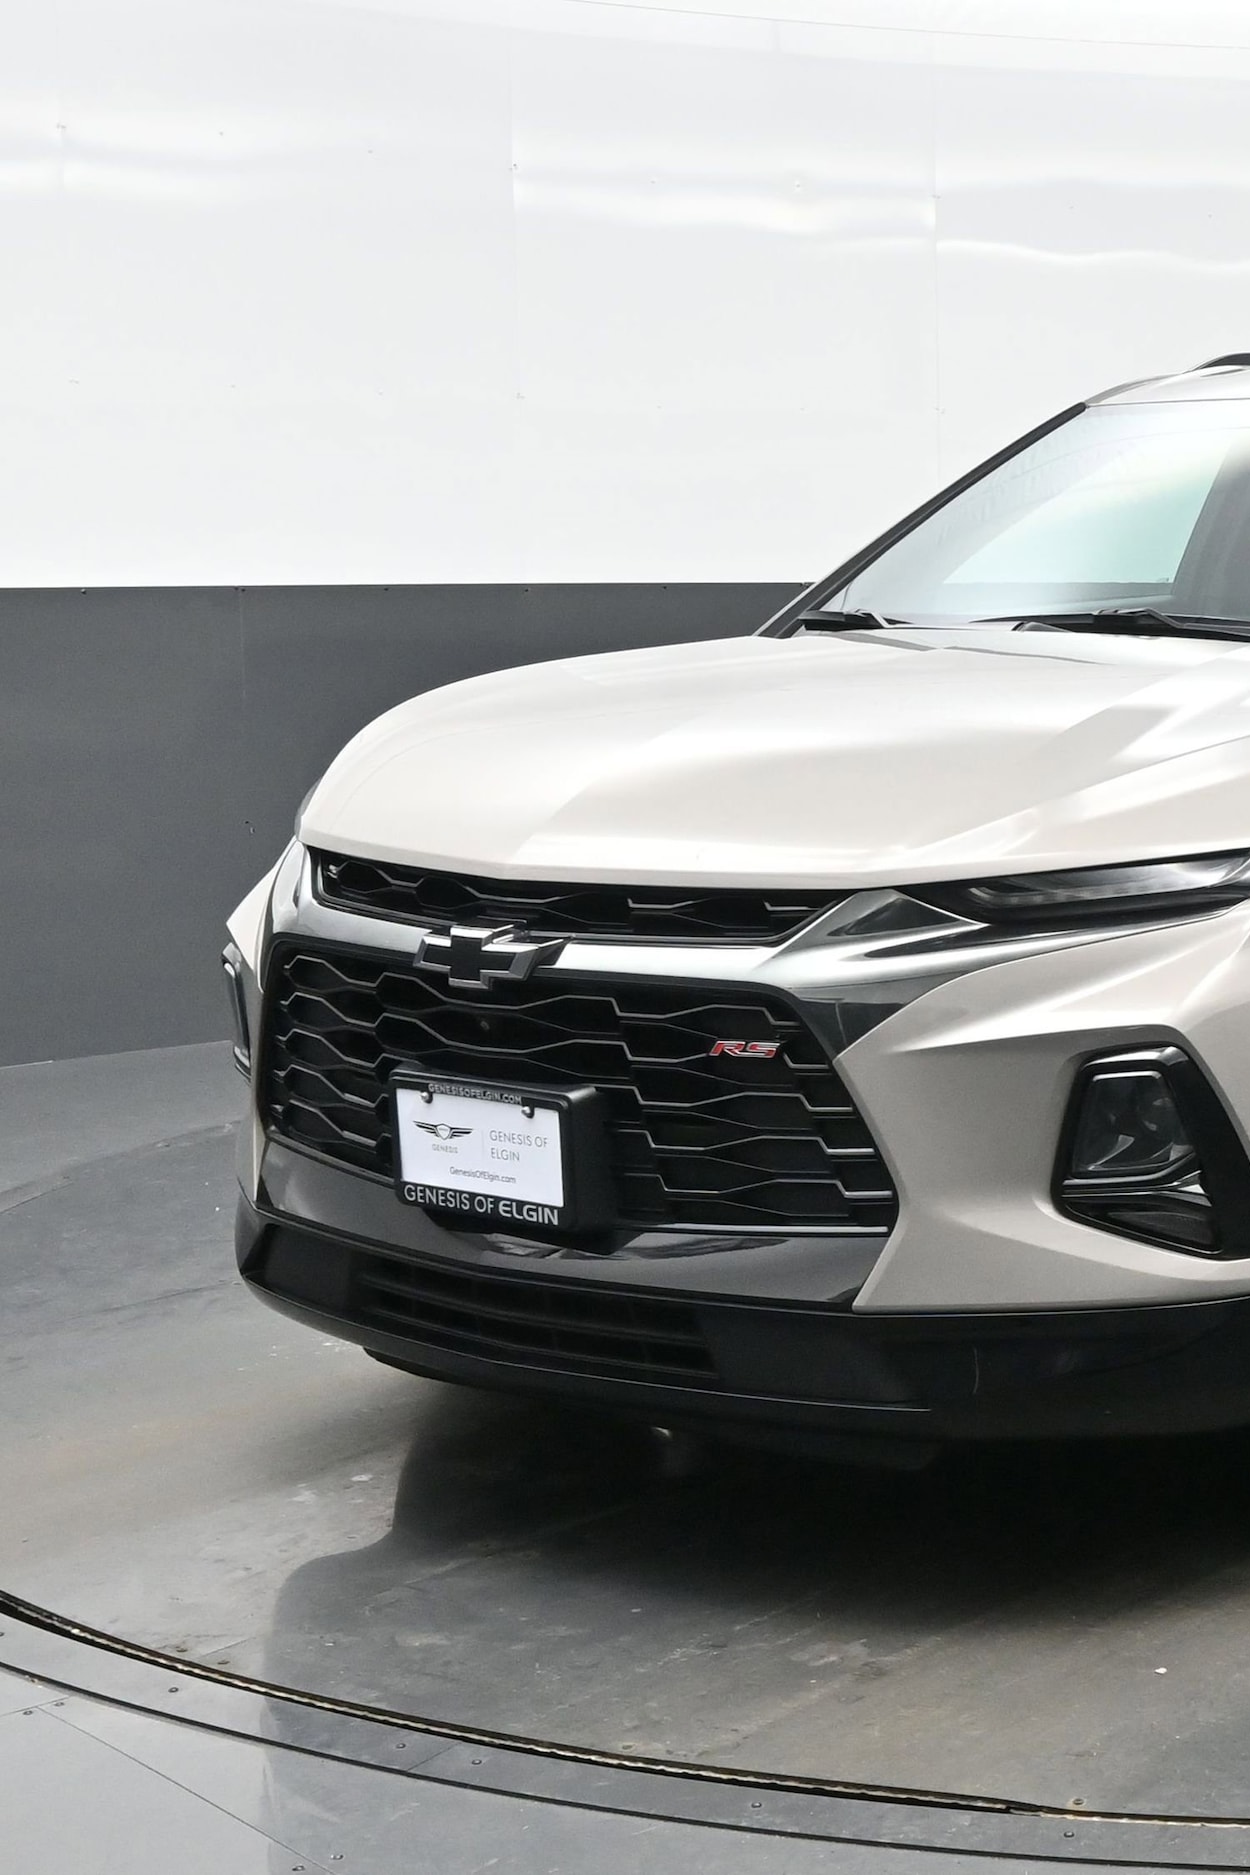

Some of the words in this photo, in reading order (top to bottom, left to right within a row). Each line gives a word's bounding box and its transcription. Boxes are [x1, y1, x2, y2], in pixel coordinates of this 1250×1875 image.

[708, 1040, 781, 1058] RS
[428, 1083, 522, 1105] GENESISOFELGIN.COM
[489, 1130, 533, 1147] GENESIS
[534, 1136, 548, 1148] OF
[491, 1147, 520, 1162] ELGIN
[449, 1166, 516, 1184] GenesisOfElgin.com
[404, 1184, 470, 1211] GENESIS
[474, 1196, 495, 1214] OF
[498, 1200, 559, 1226] ELGIN
